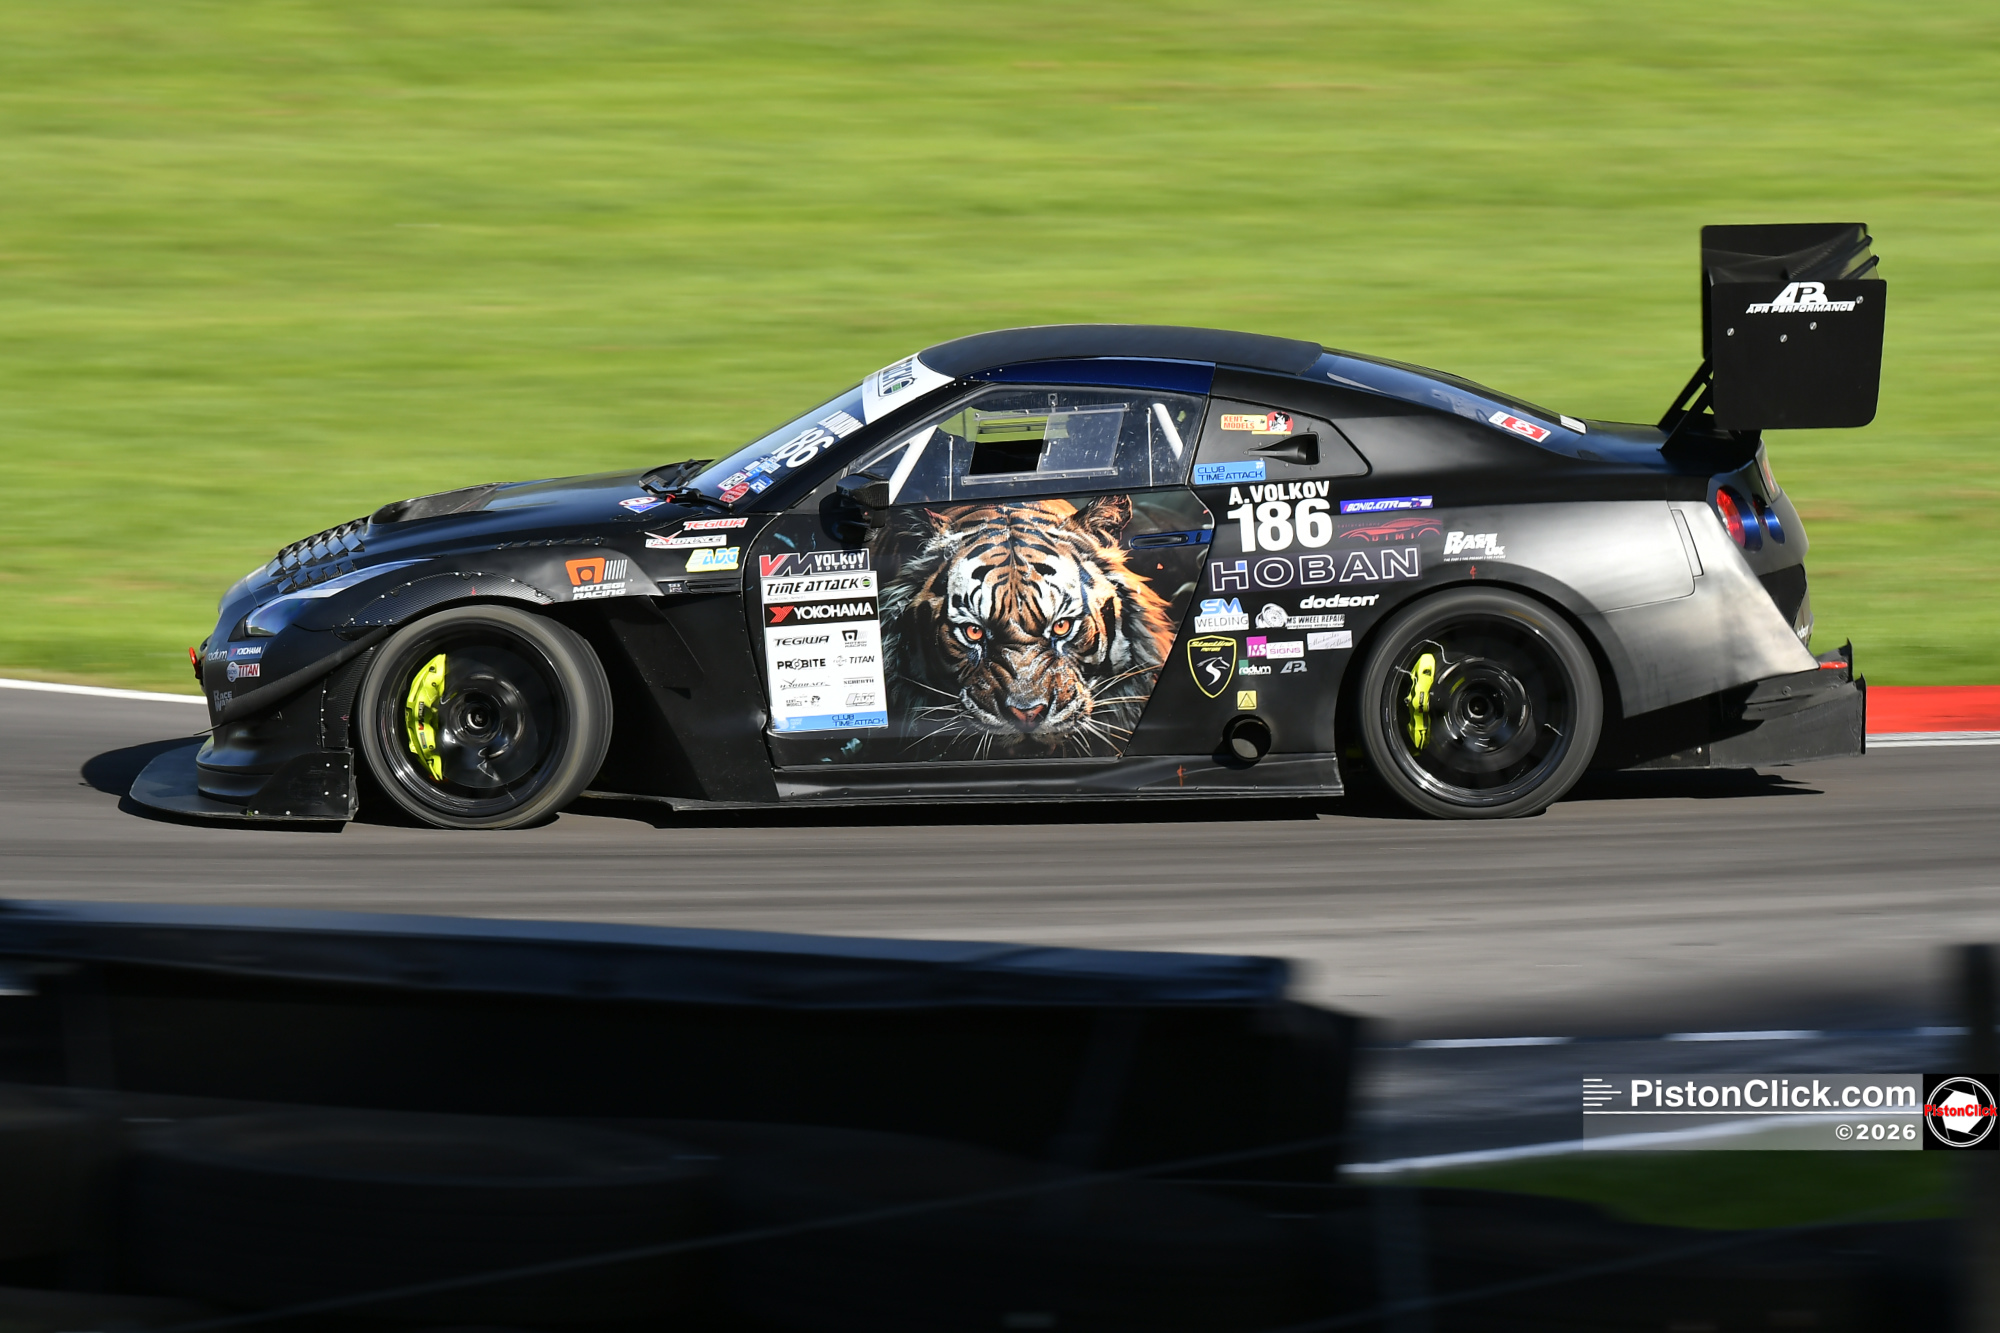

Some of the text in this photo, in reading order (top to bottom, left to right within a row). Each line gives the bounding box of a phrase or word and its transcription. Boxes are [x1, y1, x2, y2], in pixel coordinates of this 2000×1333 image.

[1746, 302, 1856, 314] APR PERFORMANCE
[1223, 415, 1243, 423] KENT
[771, 427, 835, 468] 186
[1197, 465, 1226, 474] CLUB
[1197, 470, 1263, 481] TIME ATTACK
[684, 519, 746, 529] TEGIWA
[1227, 497, 1333, 553] 186
[814, 551, 867, 567] VOLKOV
[1210, 547, 1420, 592] HOBAN
[572, 582, 626, 593] MOTEGI
[805, 577, 859, 592] ATTACK
[572, 589, 627, 600] RACING
[1199, 597, 1243, 615] SM
[1299, 594, 1380, 609] dodson
[793, 601, 874, 621] YOKOHAMA
[1196, 616, 1249, 627] WELDING
[1298, 615, 1320, 623] WHEEL
[1322, 614, 1345, 623] REPAIR
[773, 634, 831, 647] TEGIWA
[237, 647, 261, 655] YOKOHAMA
[1269, 647, 1301, 655] SIGNS
[848, 655, 875, 664] TITAN
[239, 665, 259, 677] TITAN
[213, 690, 233, 701] RACE
[854, 717, 885, 726] ATTACK
